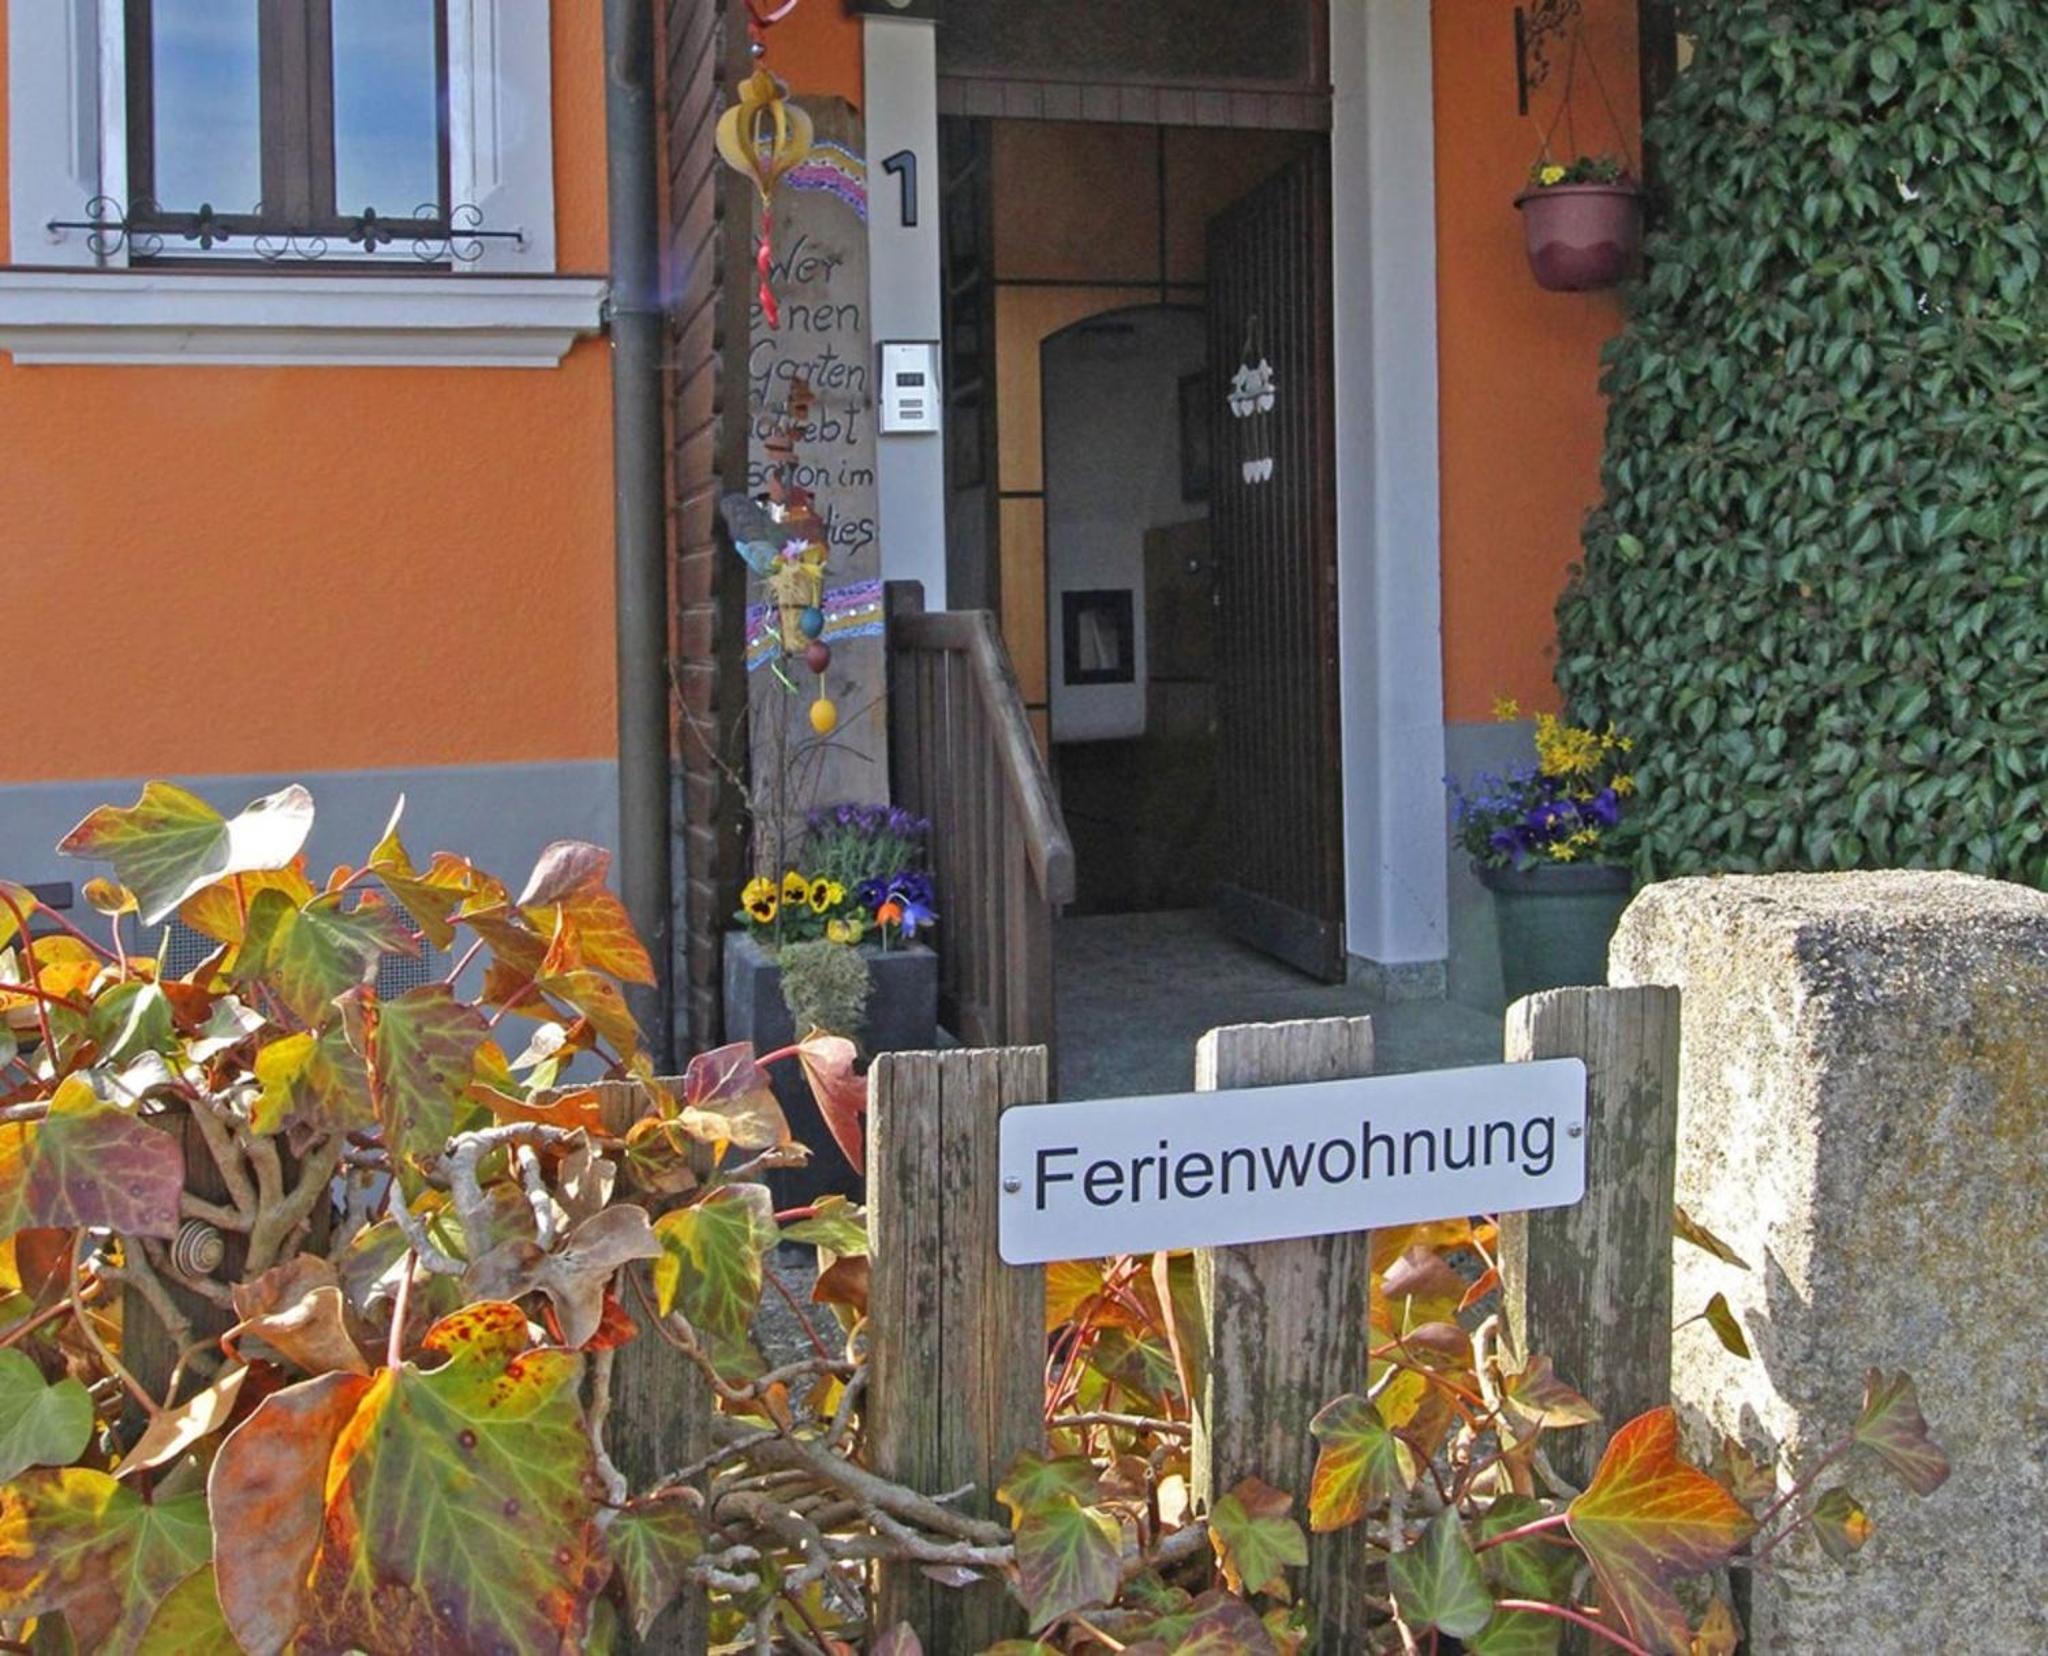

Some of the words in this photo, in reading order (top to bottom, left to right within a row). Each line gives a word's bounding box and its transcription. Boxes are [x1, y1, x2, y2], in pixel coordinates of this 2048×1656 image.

[881, 149, 917, 227] 1
[755, 234, 843, 283] Wer
[748, 303, 860, 332] enen
[749, 338, 865, 406] Garten
[794, 402, 860, 445] ebt
[839, 460, 874, 486] im
[1033, 1114, 1556, 1211] Ferienwohnung
